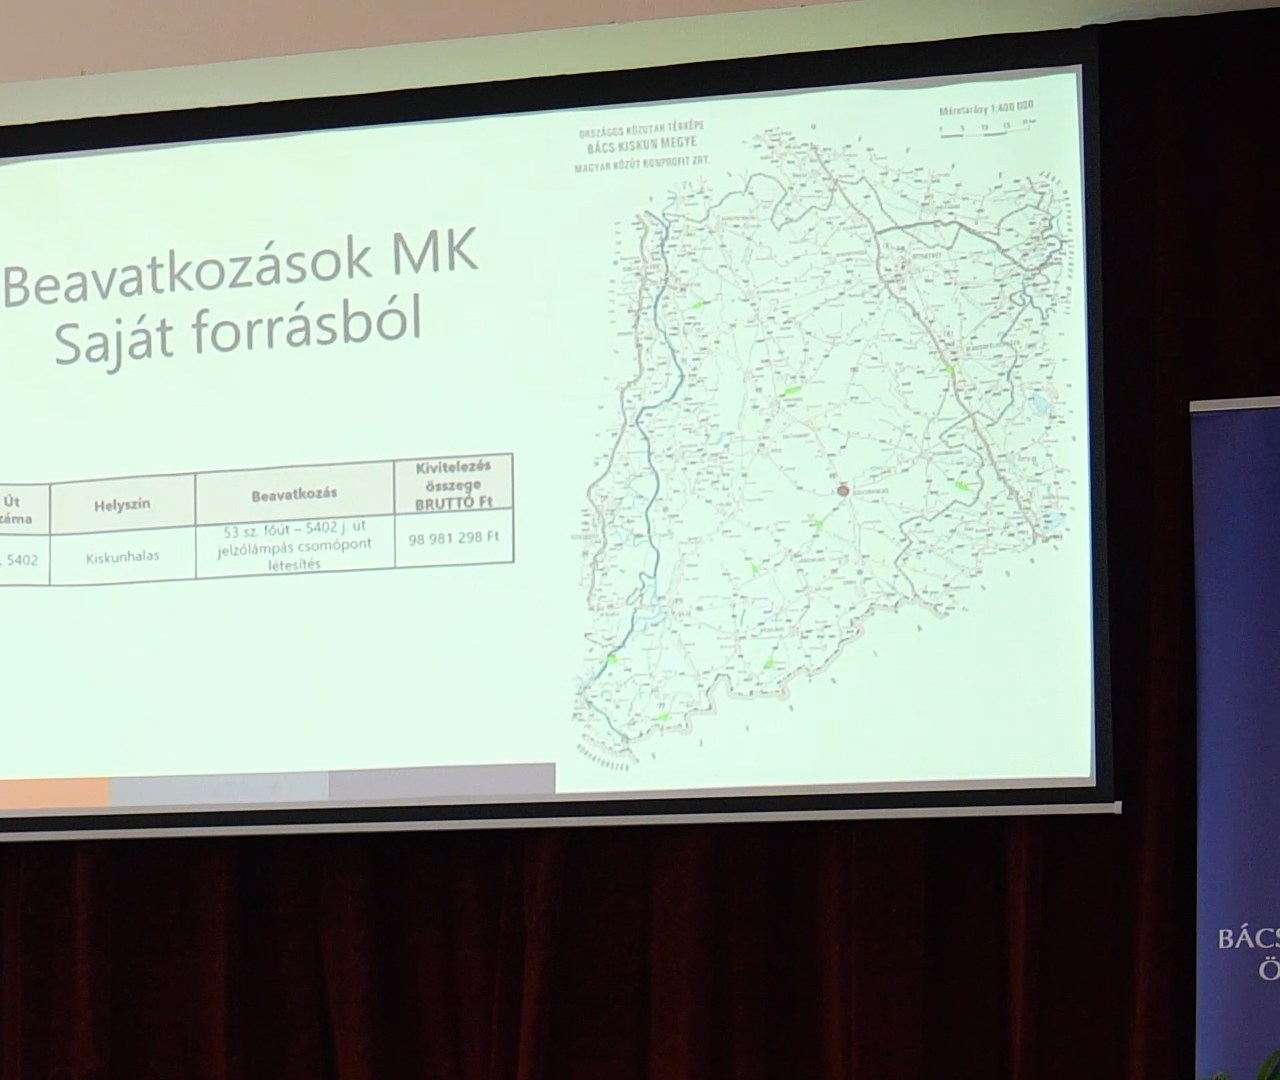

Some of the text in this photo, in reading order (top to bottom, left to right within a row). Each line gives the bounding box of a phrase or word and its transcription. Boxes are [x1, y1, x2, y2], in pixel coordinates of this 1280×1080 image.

[661, 135, 697, 148] MEGYE
[3, 226, 479, 308] Beavatkozások MK
[55, 293, 421, 375] Saját forrásból
[416, 460, 491, 475] Kivitelezés
[252, 486, 338, 503] Beavatkozás
[426, 480, 481, 494] összege
[4, 493, 20, 508] Út
[94, 497, 151, 514] Helyszín
[415, 494, 493, 511] BRUTTÓ Ft
[224, 526, 239, 539] 53
[243, 527, 258, 538] sz.
[264, 523, 290, 537] főút
[306, 521, 338, 534] 5402
[353, 519, 366, 532] út
[409, 530, 500, 546] 98 981 298 Ft
[217, 537, 372, 561] jelzőlámpás csomópont
[7, 554, 38, 567] 5402
[86, 550, 160, 565] Kiskunhalas
[268, 557, 321, 572] létesítés
